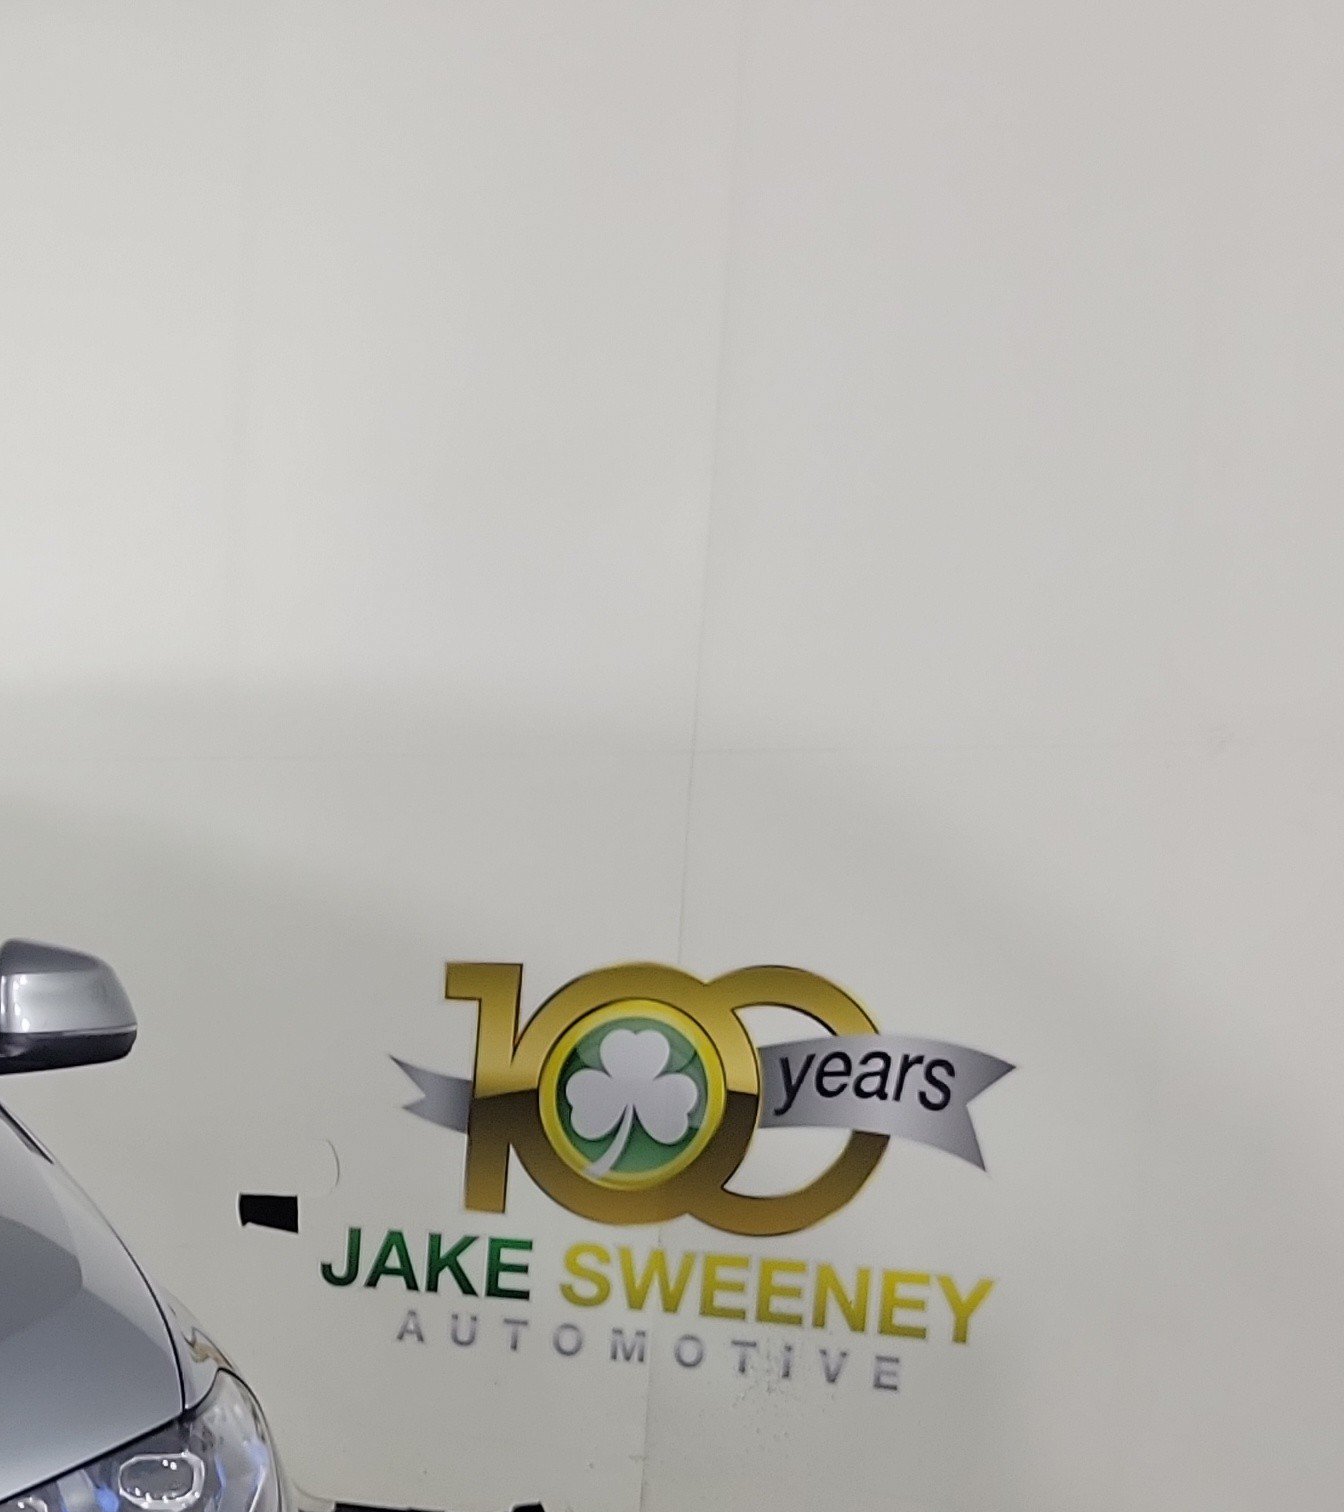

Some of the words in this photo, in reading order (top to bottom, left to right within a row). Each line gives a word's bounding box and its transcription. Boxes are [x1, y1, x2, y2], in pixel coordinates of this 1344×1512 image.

[444, 961, 891, 1237] 100
[772, 1049, 956, 1115] years
[320, 1227, 534, 1301] JAKE
[558, 1240, 995, 1344] SWEENEY
[396, 1310, 902, 1391] AUTOMOTIVE
